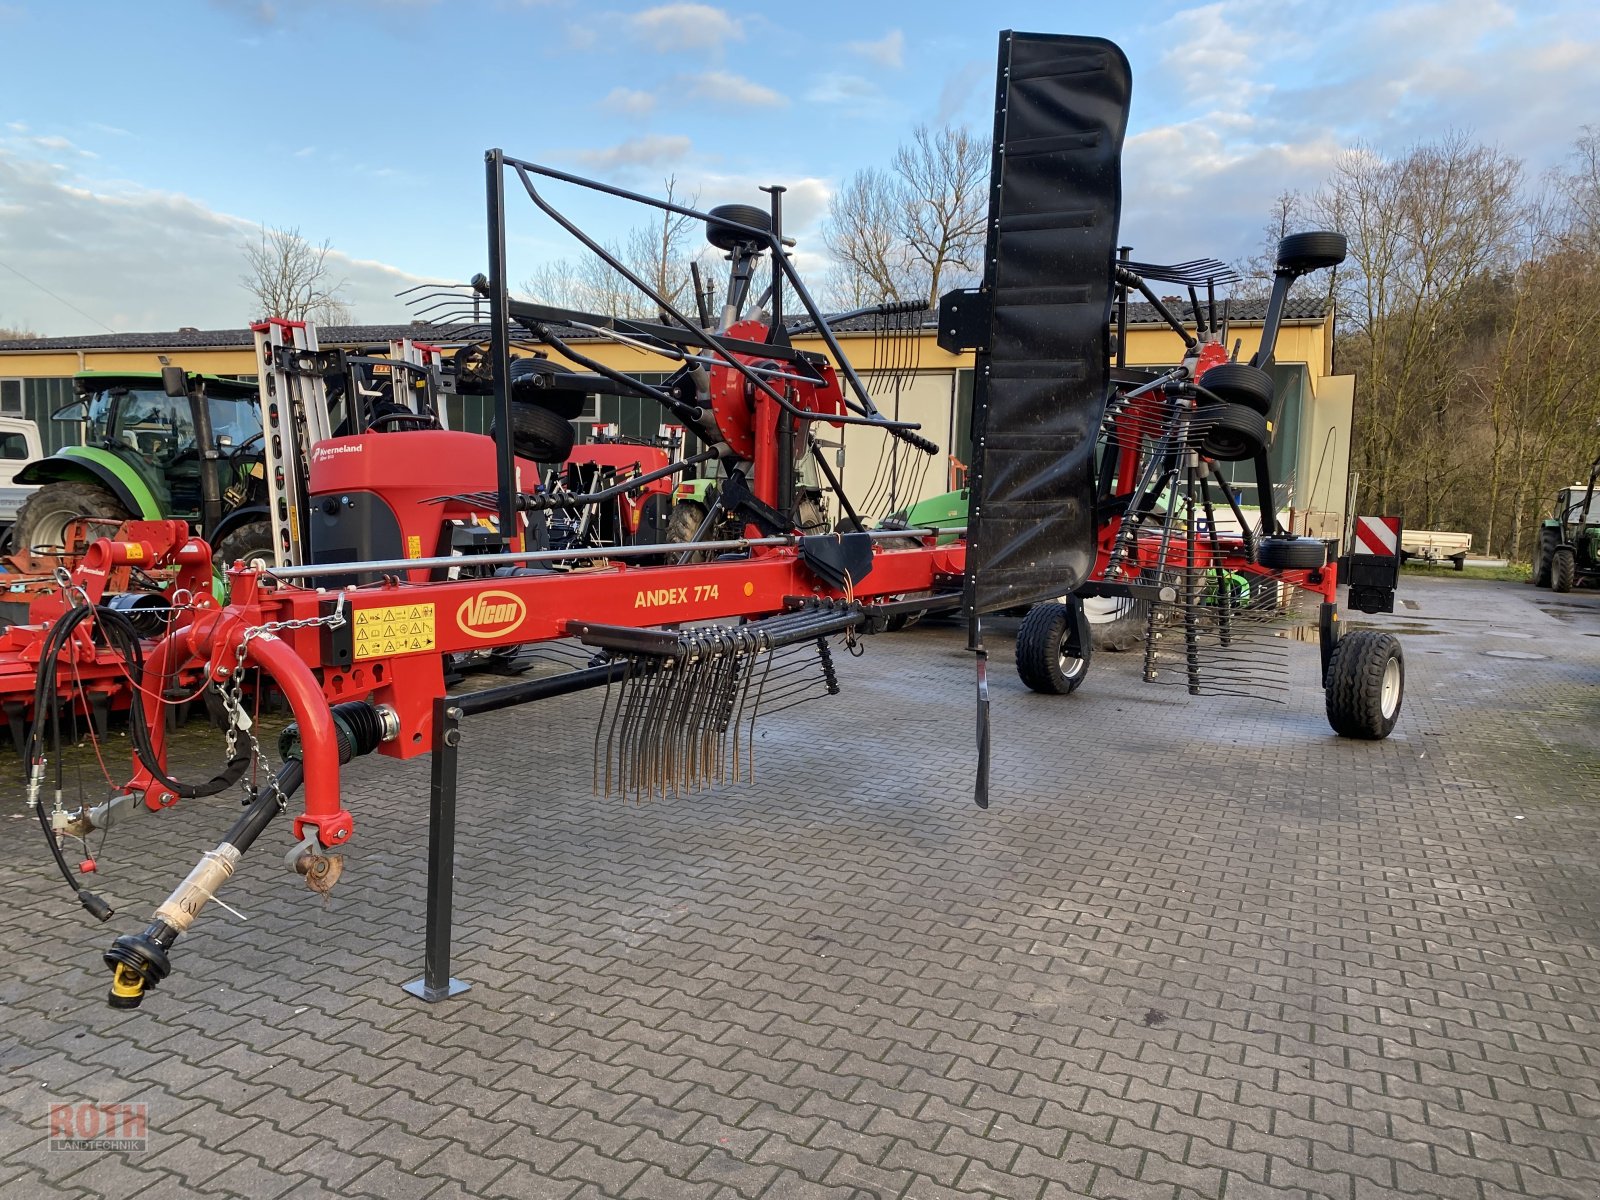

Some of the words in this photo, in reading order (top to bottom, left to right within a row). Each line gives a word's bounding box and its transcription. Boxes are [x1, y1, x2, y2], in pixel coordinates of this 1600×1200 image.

[320, 443, 363, 456] Kverneland
[634, 586, 688, 609] ANDEX
[693, 584, 719, 603] 774
[467, 595, 518, 626] Vicon
